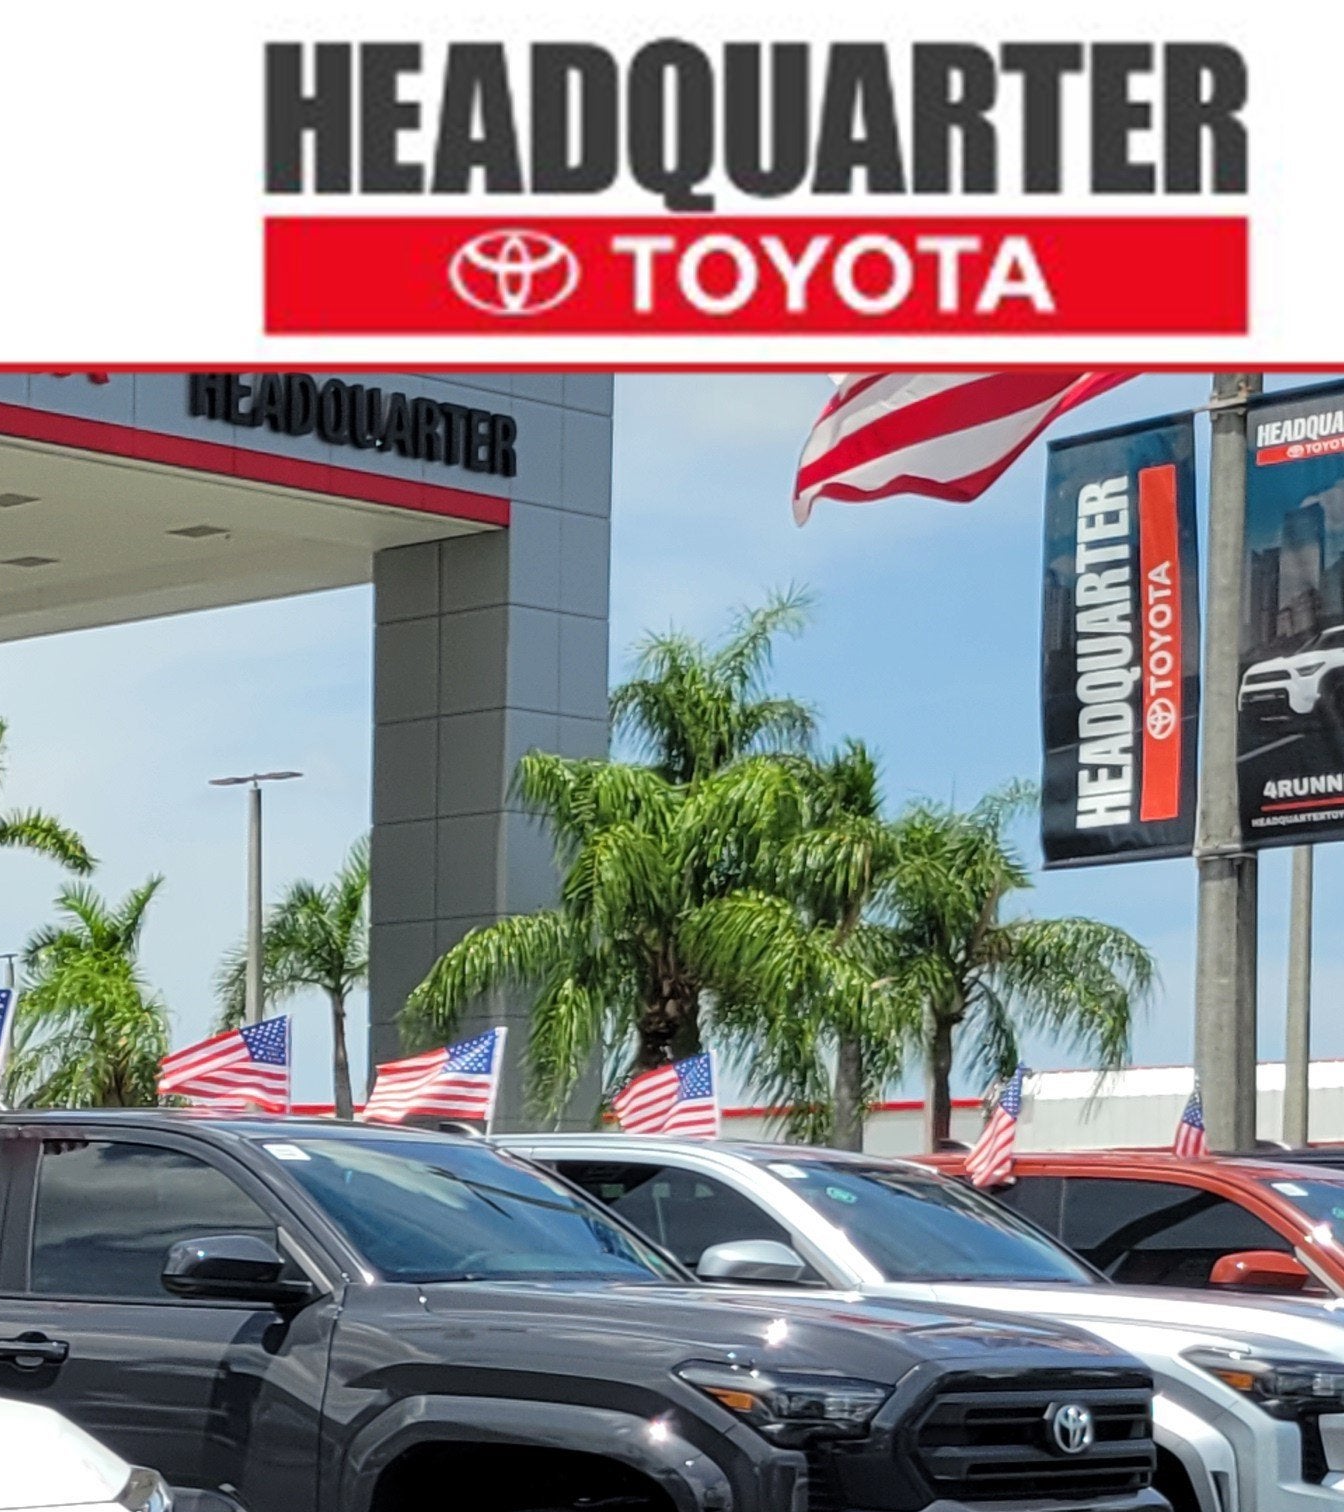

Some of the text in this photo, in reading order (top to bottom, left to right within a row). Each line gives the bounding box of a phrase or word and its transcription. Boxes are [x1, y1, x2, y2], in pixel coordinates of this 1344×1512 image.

[187, 372, 517, 477] HEADQUARTER
[1256, 410, 1344, 448] HEADQUA
[1075, 475, 1140, 830] HEADQUARTER
[1147, 560, 1173, 696] TOYOTA
[1263, 773, 1344, 799] 4RUNN
